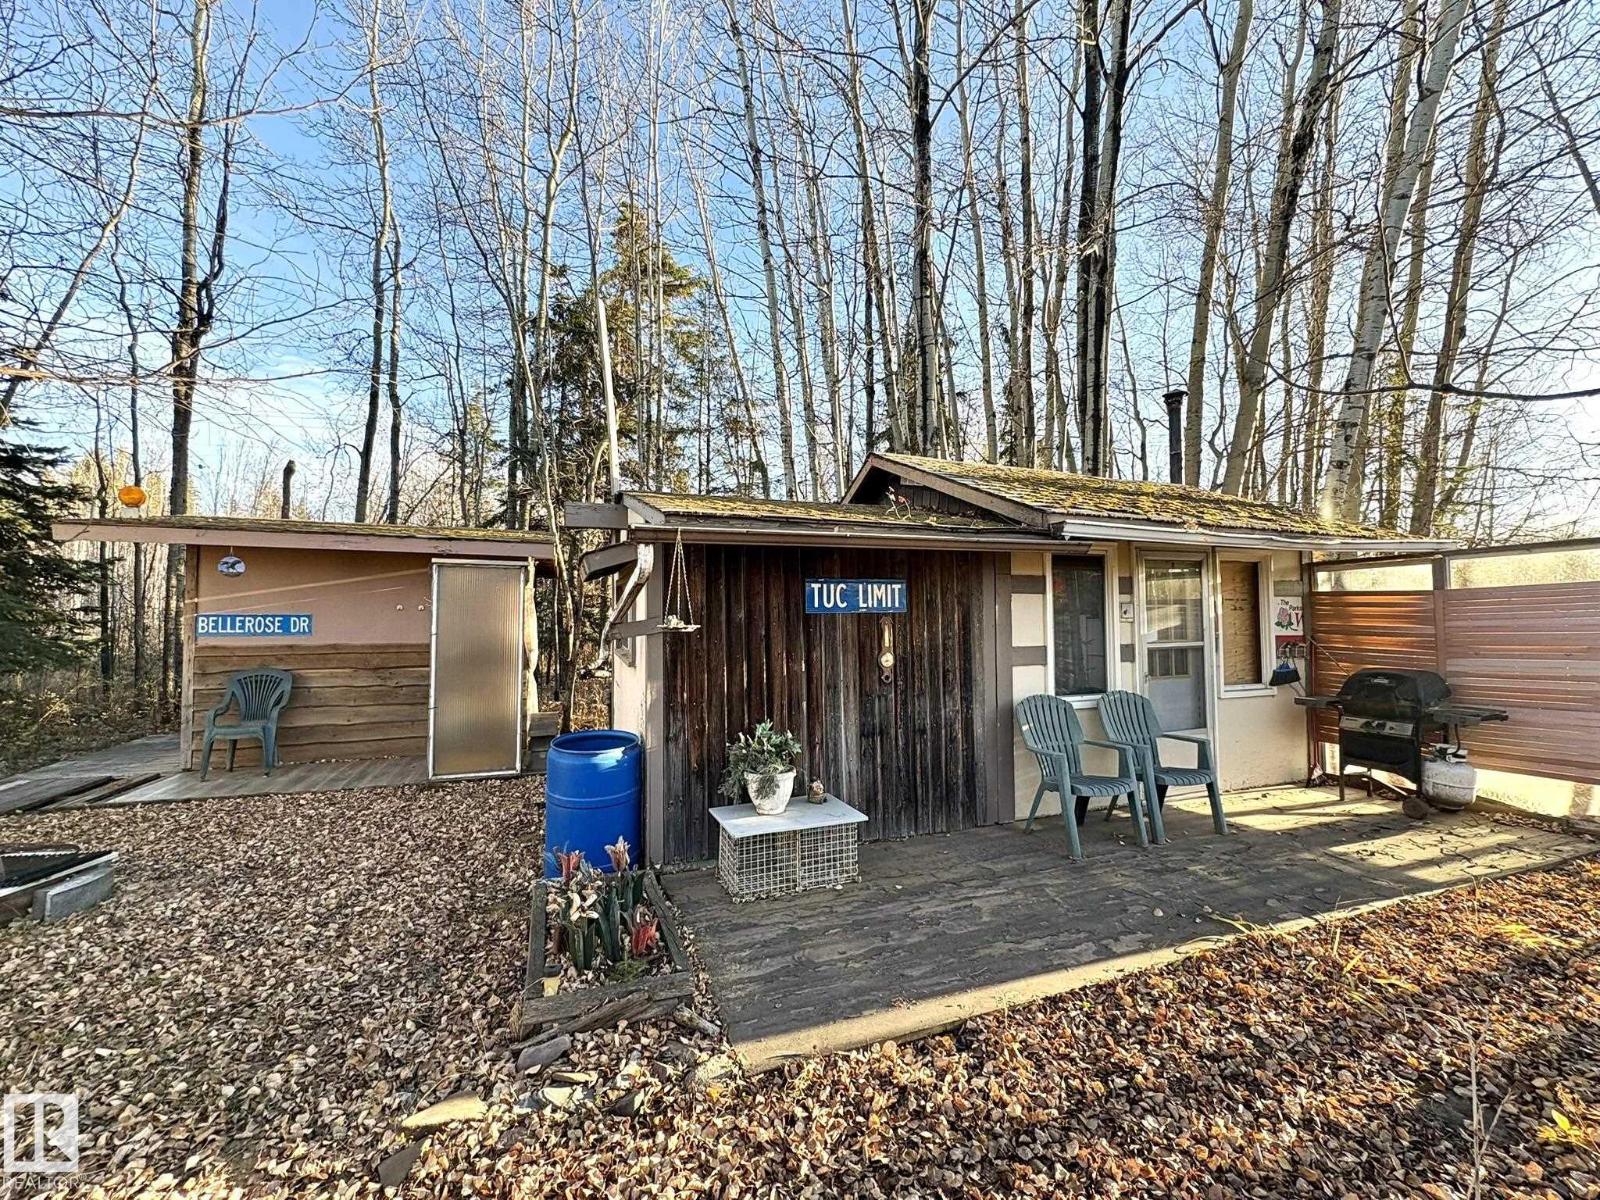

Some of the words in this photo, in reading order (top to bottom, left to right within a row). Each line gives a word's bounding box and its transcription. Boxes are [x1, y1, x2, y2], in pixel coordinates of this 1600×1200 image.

[811, 584, 847, 608] TUC
[859, 583, 901, 608] LIMIT
[198, 616, 283, 633] BELLEROSE
[290, 616, 309, 633] DR
